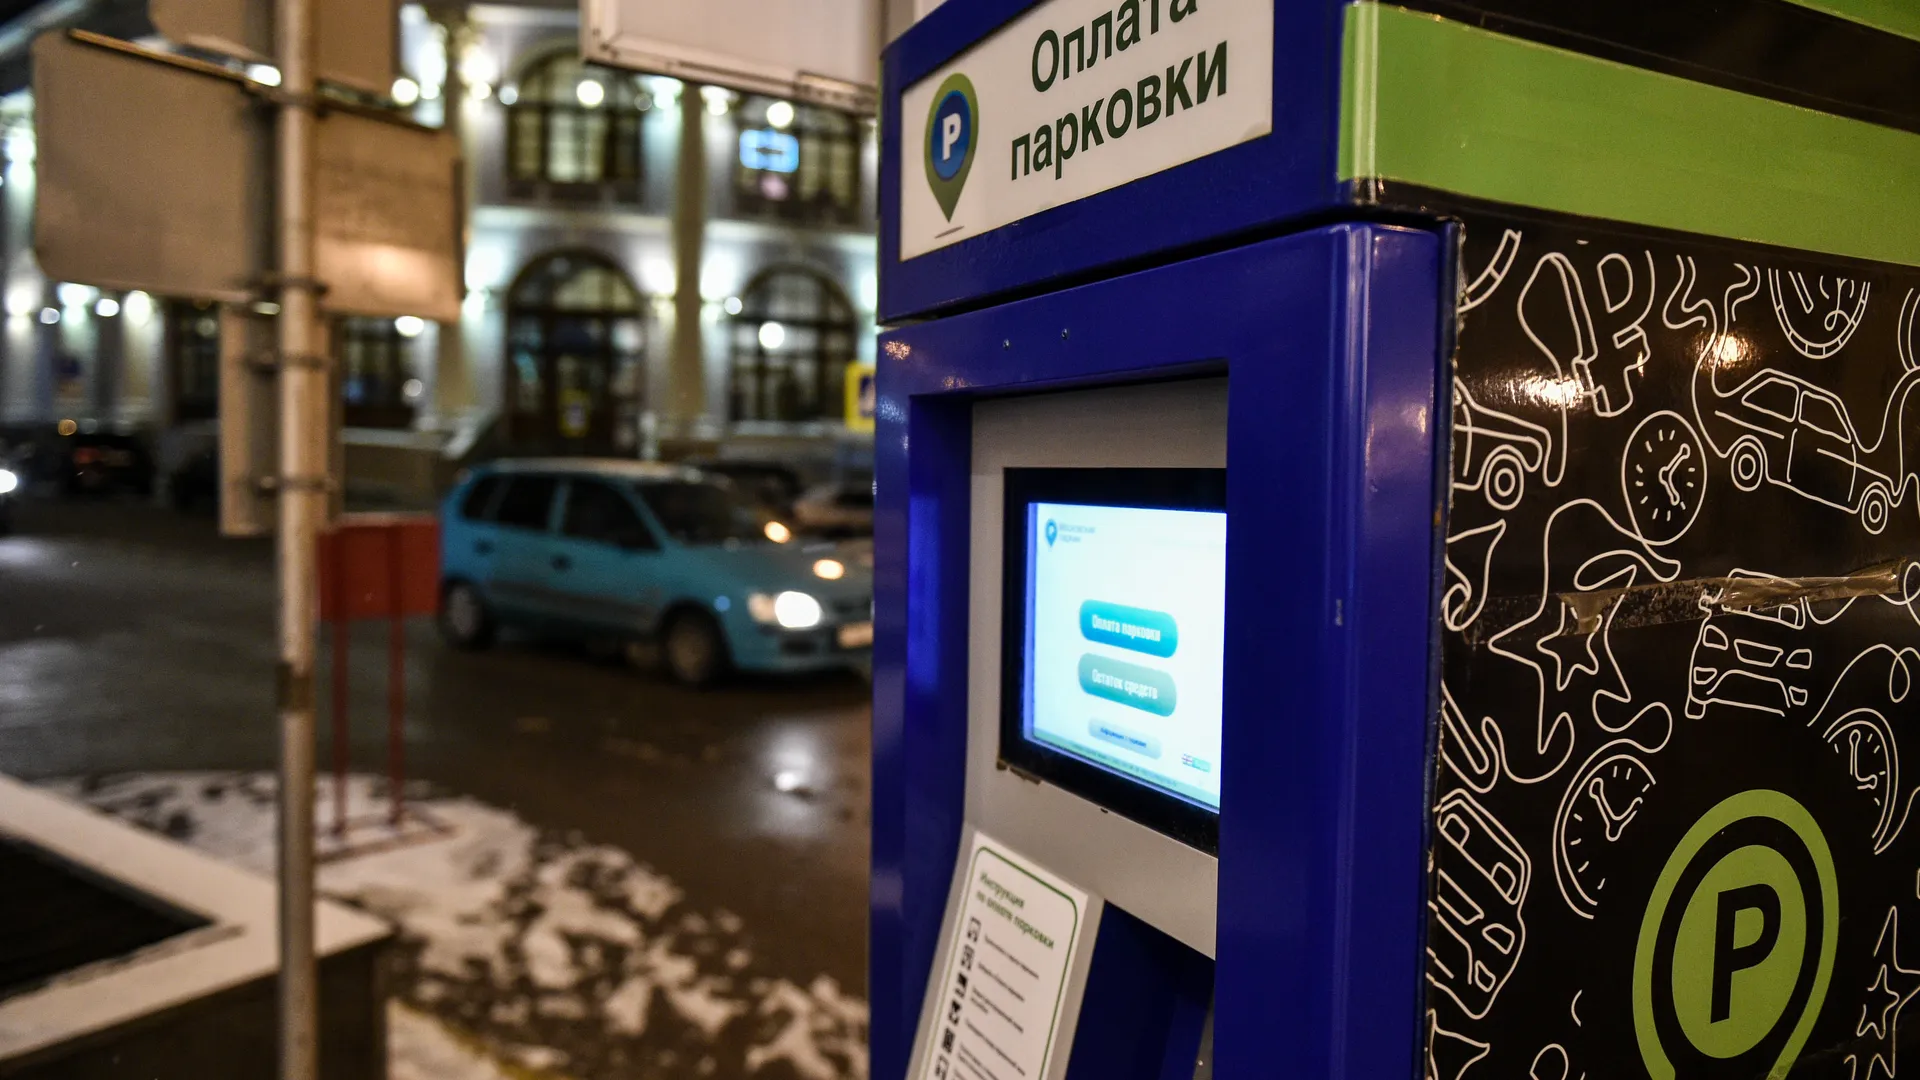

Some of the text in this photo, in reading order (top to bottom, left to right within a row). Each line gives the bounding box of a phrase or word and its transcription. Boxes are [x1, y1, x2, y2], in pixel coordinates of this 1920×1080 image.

[1031, 0, 1199, 93] Оплата
[1010, 40, 1228, 181] парковки
[942, 112, 962, 161] P
[1092, 613, 1121, 634] Оплата
[1091, 668, 1158, 700] Остаток средств
[980, 872, 1025, 908] Инструкция
[986, 897, 1014, 922] оплате
[1013, 916, 1055, 949] парковки
[1710, 882, 1782, 1025] P
